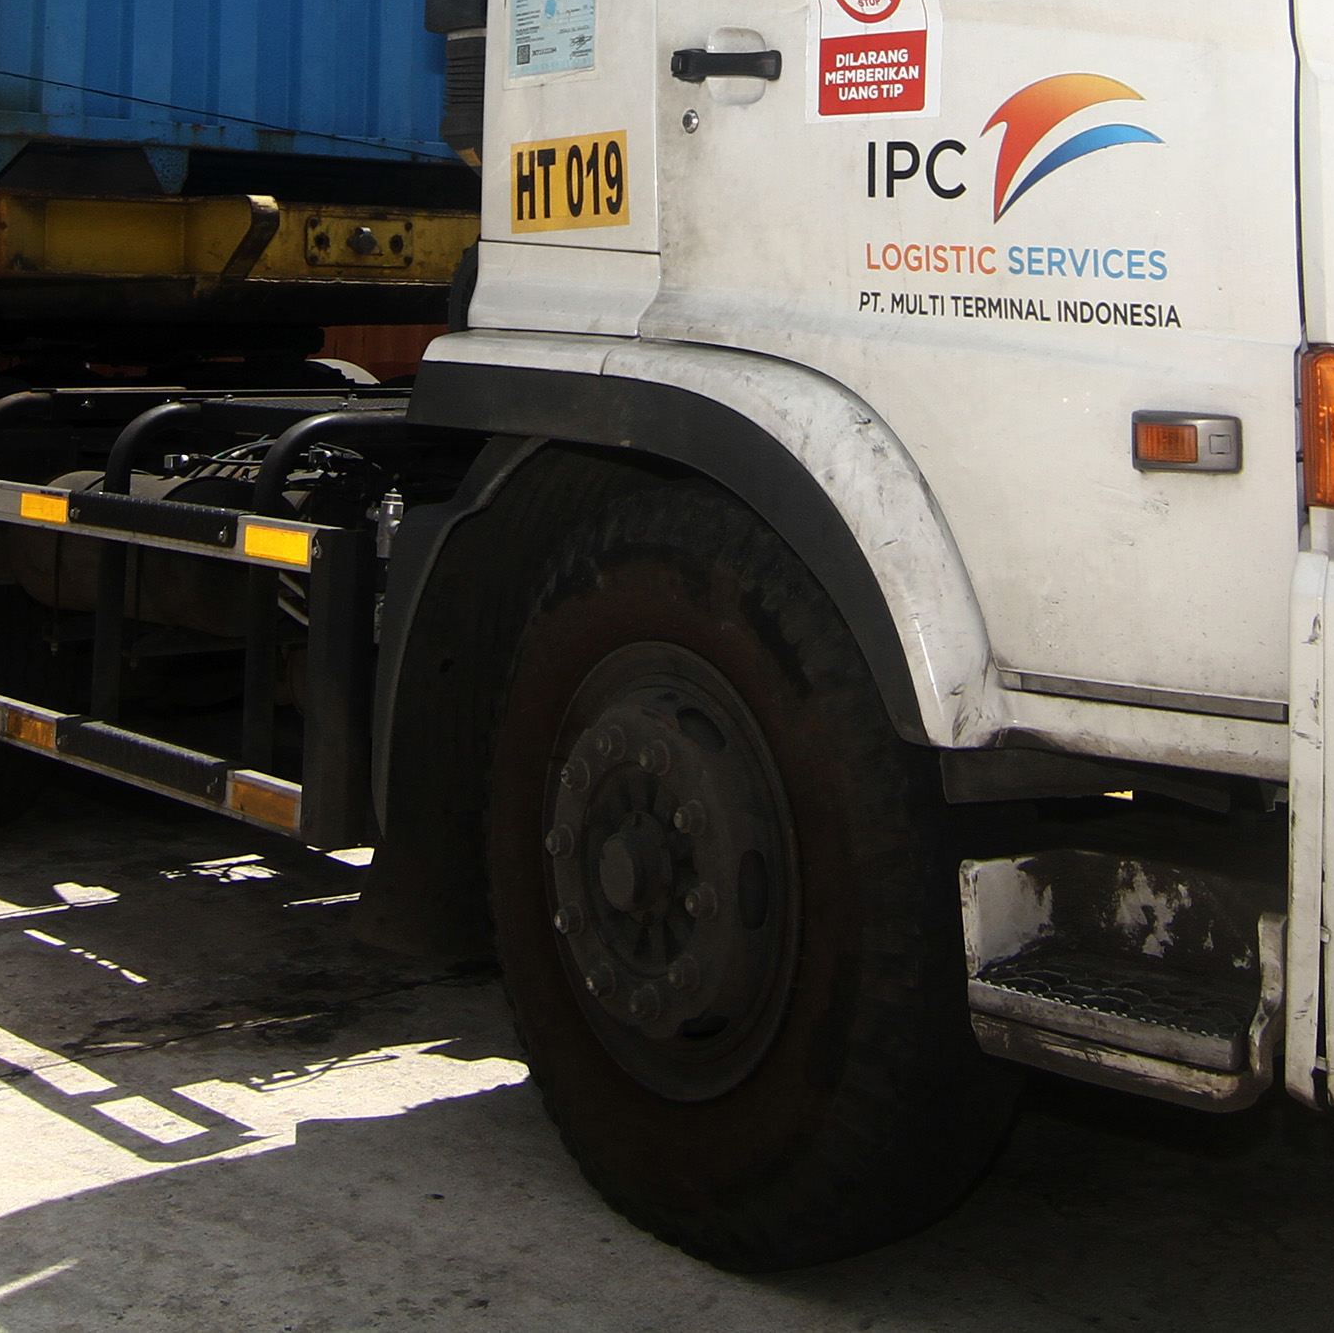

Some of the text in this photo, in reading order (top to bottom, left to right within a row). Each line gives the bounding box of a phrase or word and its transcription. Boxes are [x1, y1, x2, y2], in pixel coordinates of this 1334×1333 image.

[824, 65, 920, 86] MEMBERIKAN
[835, 48, 909, 68] DILARANG
[838, 83, 904, 101] UANG TIP
[515, 139, 624, 222] HT 019
[865, 138, 967, 199] IPC
[865, 241, 1168, 281] LOGISTIC SERVICES
[858, 292, 1182, 330] PT. MULTI TERMINAL INDONESIA
